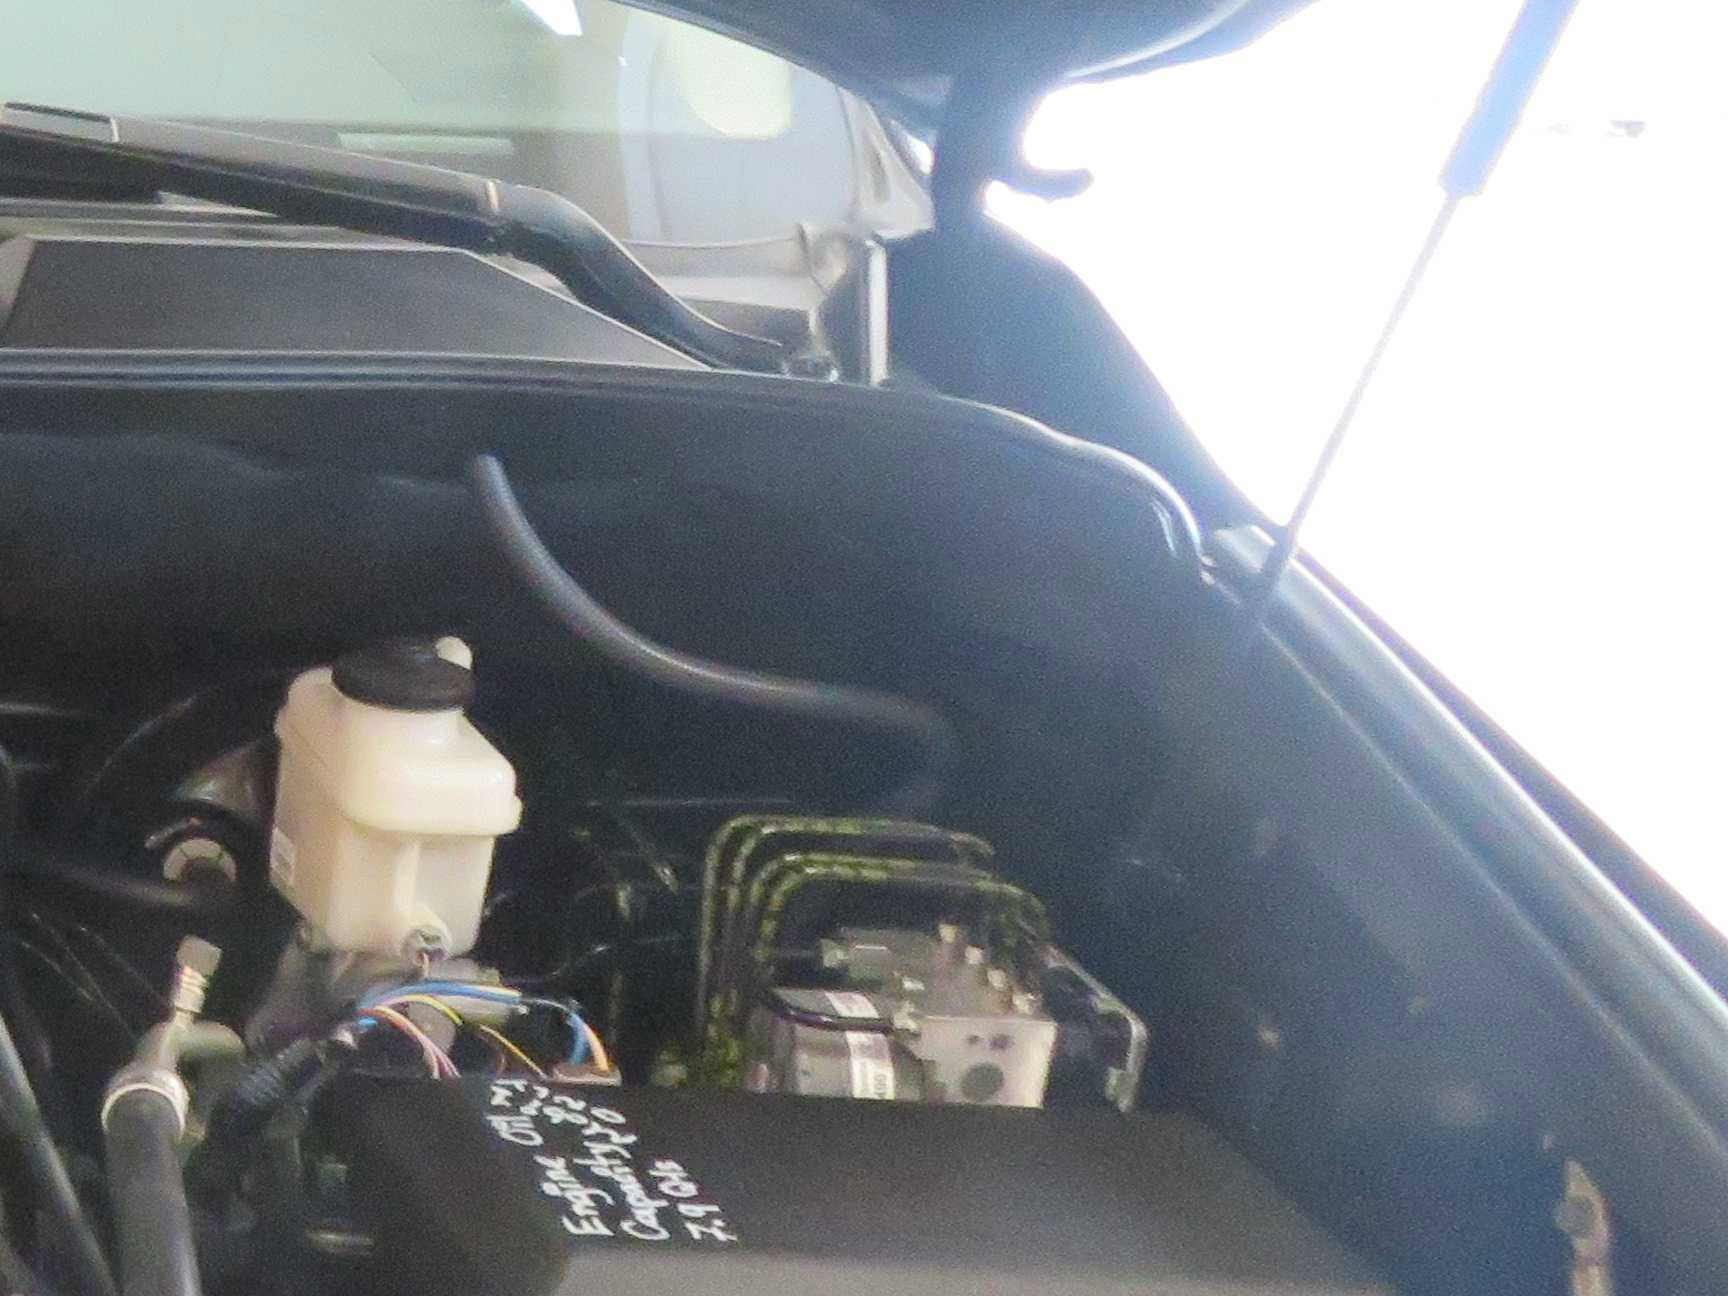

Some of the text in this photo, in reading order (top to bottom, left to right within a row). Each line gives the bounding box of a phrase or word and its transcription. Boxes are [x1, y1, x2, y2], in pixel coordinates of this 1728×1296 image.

[486, 1115, 615, 1236] Engine Oil
[573, 1140, 671, 1241] Capacity
[676, 1202, 739, 1242] 7.9
